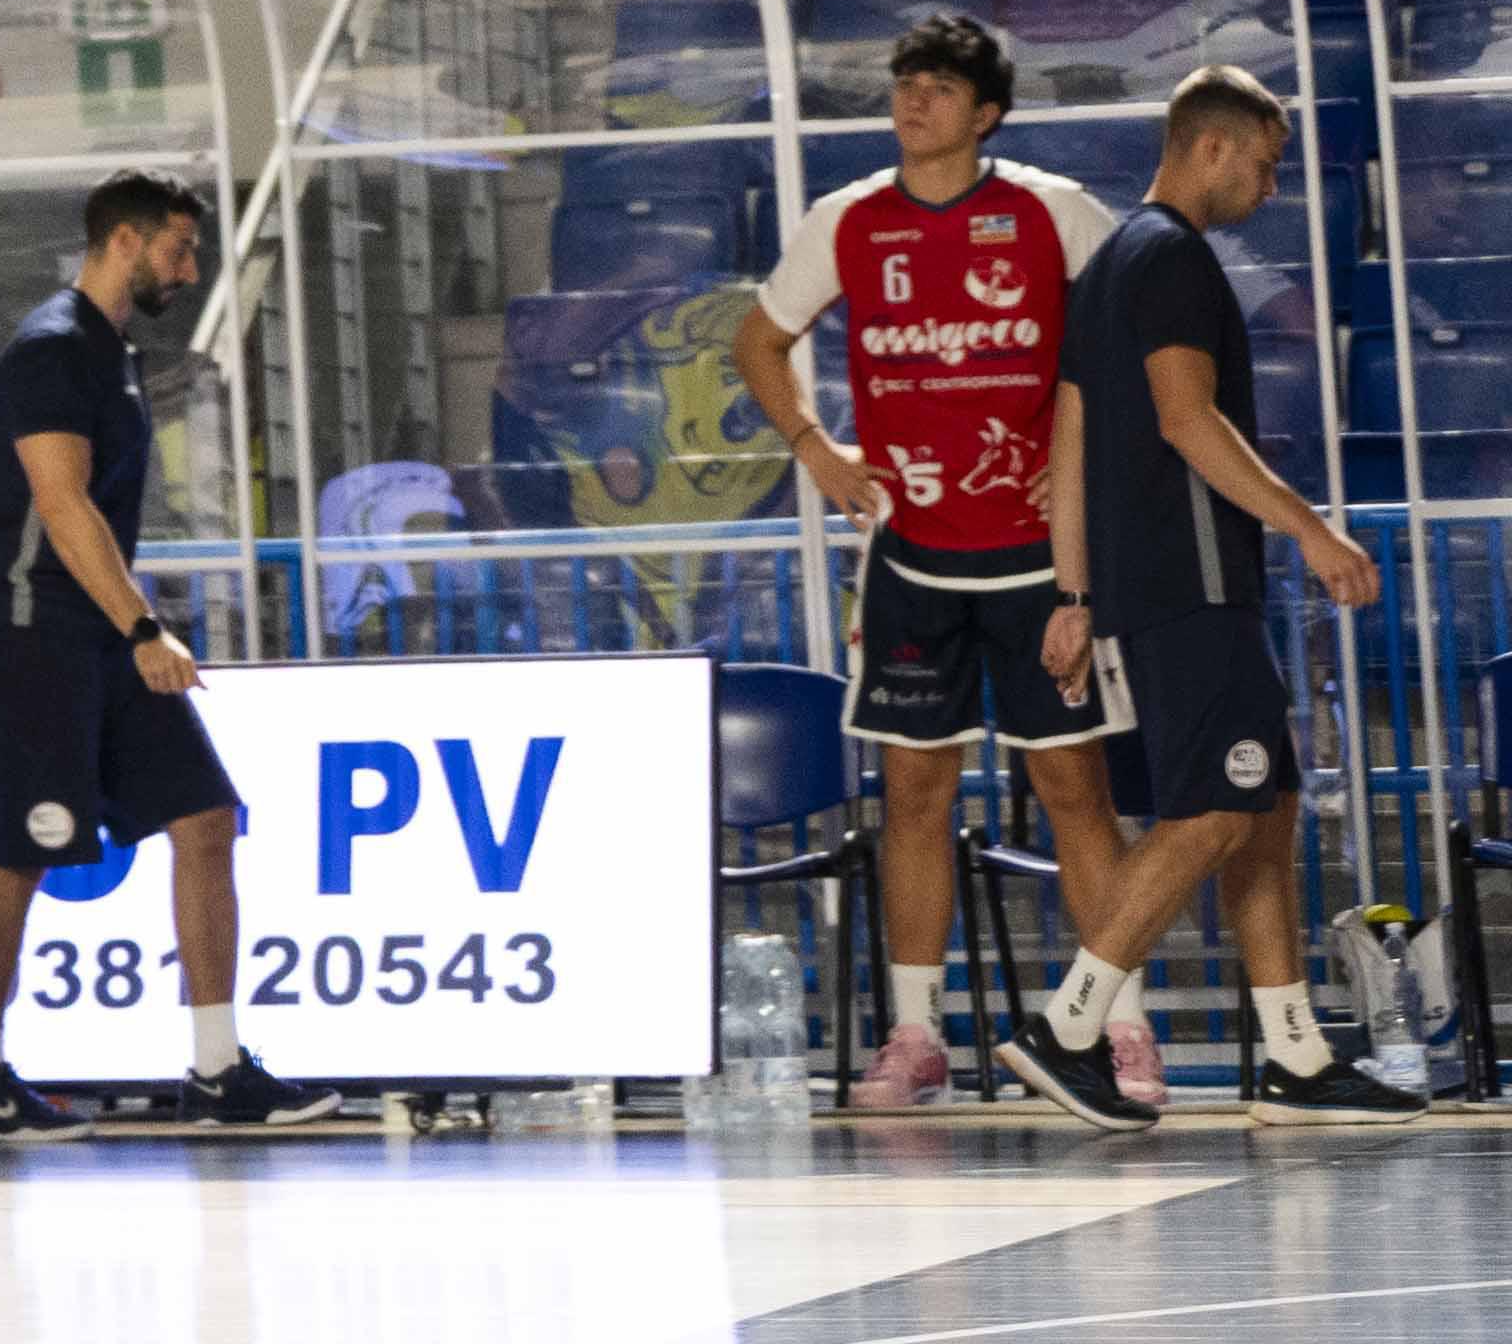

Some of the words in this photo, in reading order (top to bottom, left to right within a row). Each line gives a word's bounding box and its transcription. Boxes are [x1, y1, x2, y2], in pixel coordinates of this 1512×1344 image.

[881, 253, 912, 303] 6
[316, 736, 566, 896] PV
[249, 932, 559, 1009] 20543
